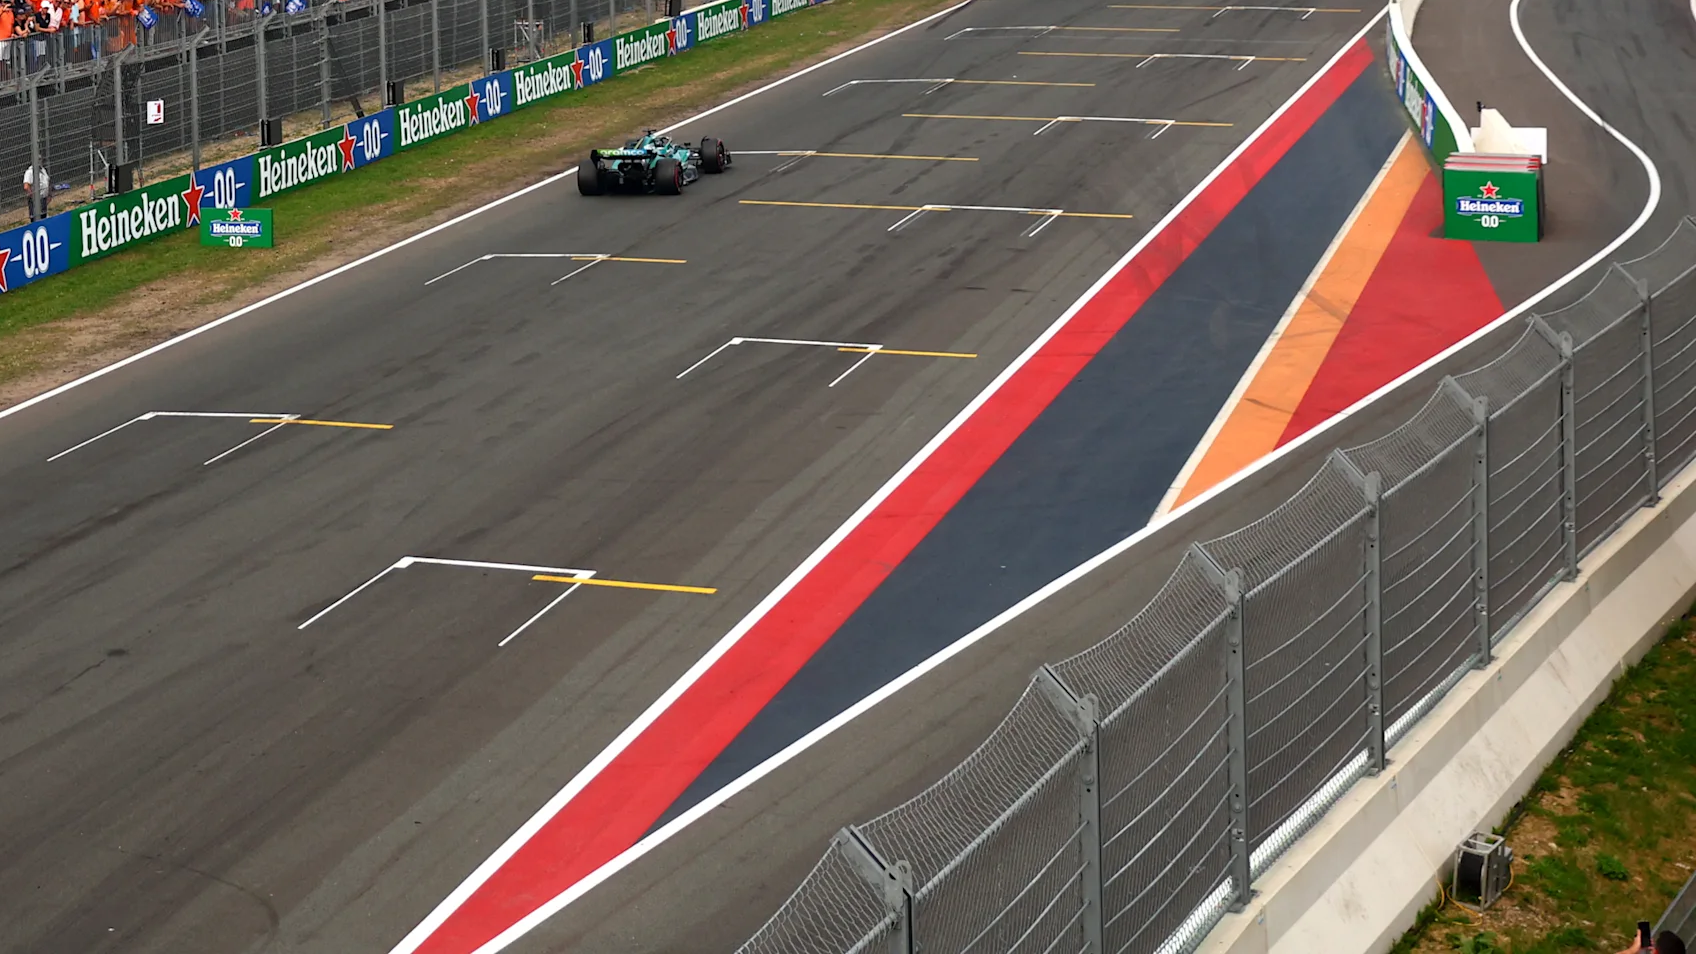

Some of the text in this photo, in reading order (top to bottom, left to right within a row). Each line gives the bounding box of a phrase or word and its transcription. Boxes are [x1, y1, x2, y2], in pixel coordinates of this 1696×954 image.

[697, 8, 740, 41] Heineken
[616, 29, 666, 70] Heineken
[514, 62, 571, 105] Heineken
[399, 97, 465, 146] Heineken
[259, 141, 338, 197] Heineken
[80, 193, 181, 258] Heineken
[212, 222, 259, 234] Heineken
[1460, 201, 1520, 214] Heineken
[22, 226, 50, 279] 0.0
